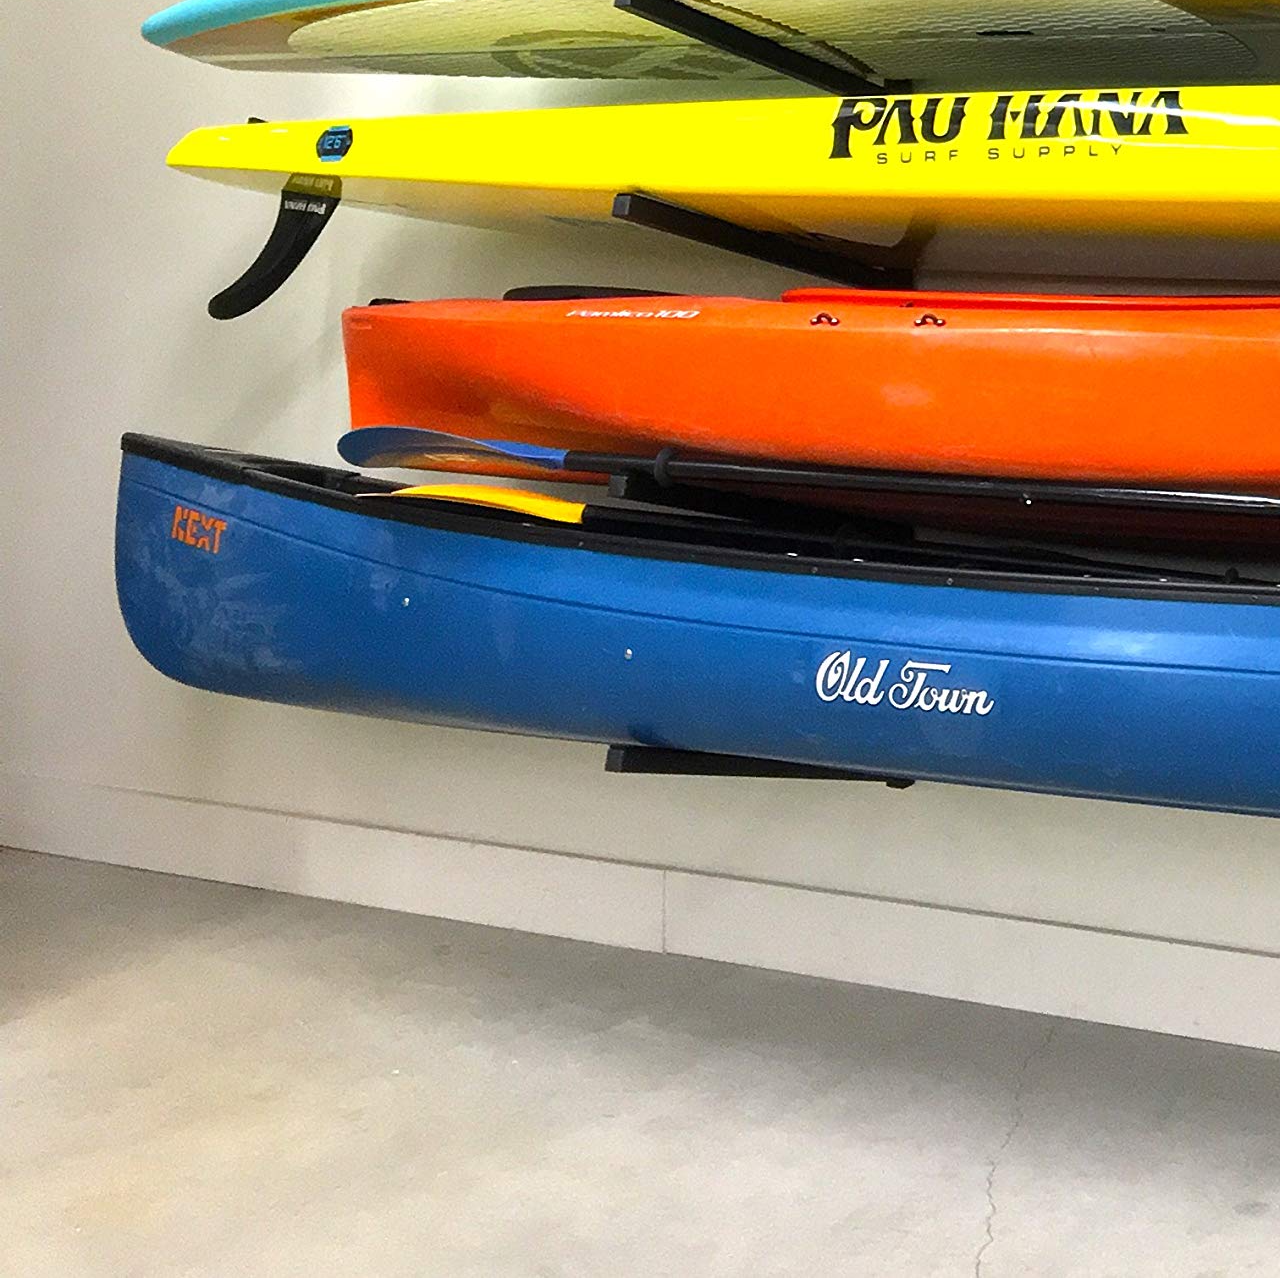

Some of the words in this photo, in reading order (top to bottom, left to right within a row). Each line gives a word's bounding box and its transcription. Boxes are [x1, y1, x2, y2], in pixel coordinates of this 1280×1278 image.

[828, 96, 971, 159] PAU
[987, 91, 1189, 141] HANA
[876, 149, 959, 165] SURF
[988, 144, 1122, 160] SUPPLY
[171, 505, 228, 554] NEXT
[815, 650, 890, 706] Old
[889, 660, 995, 716] Town
